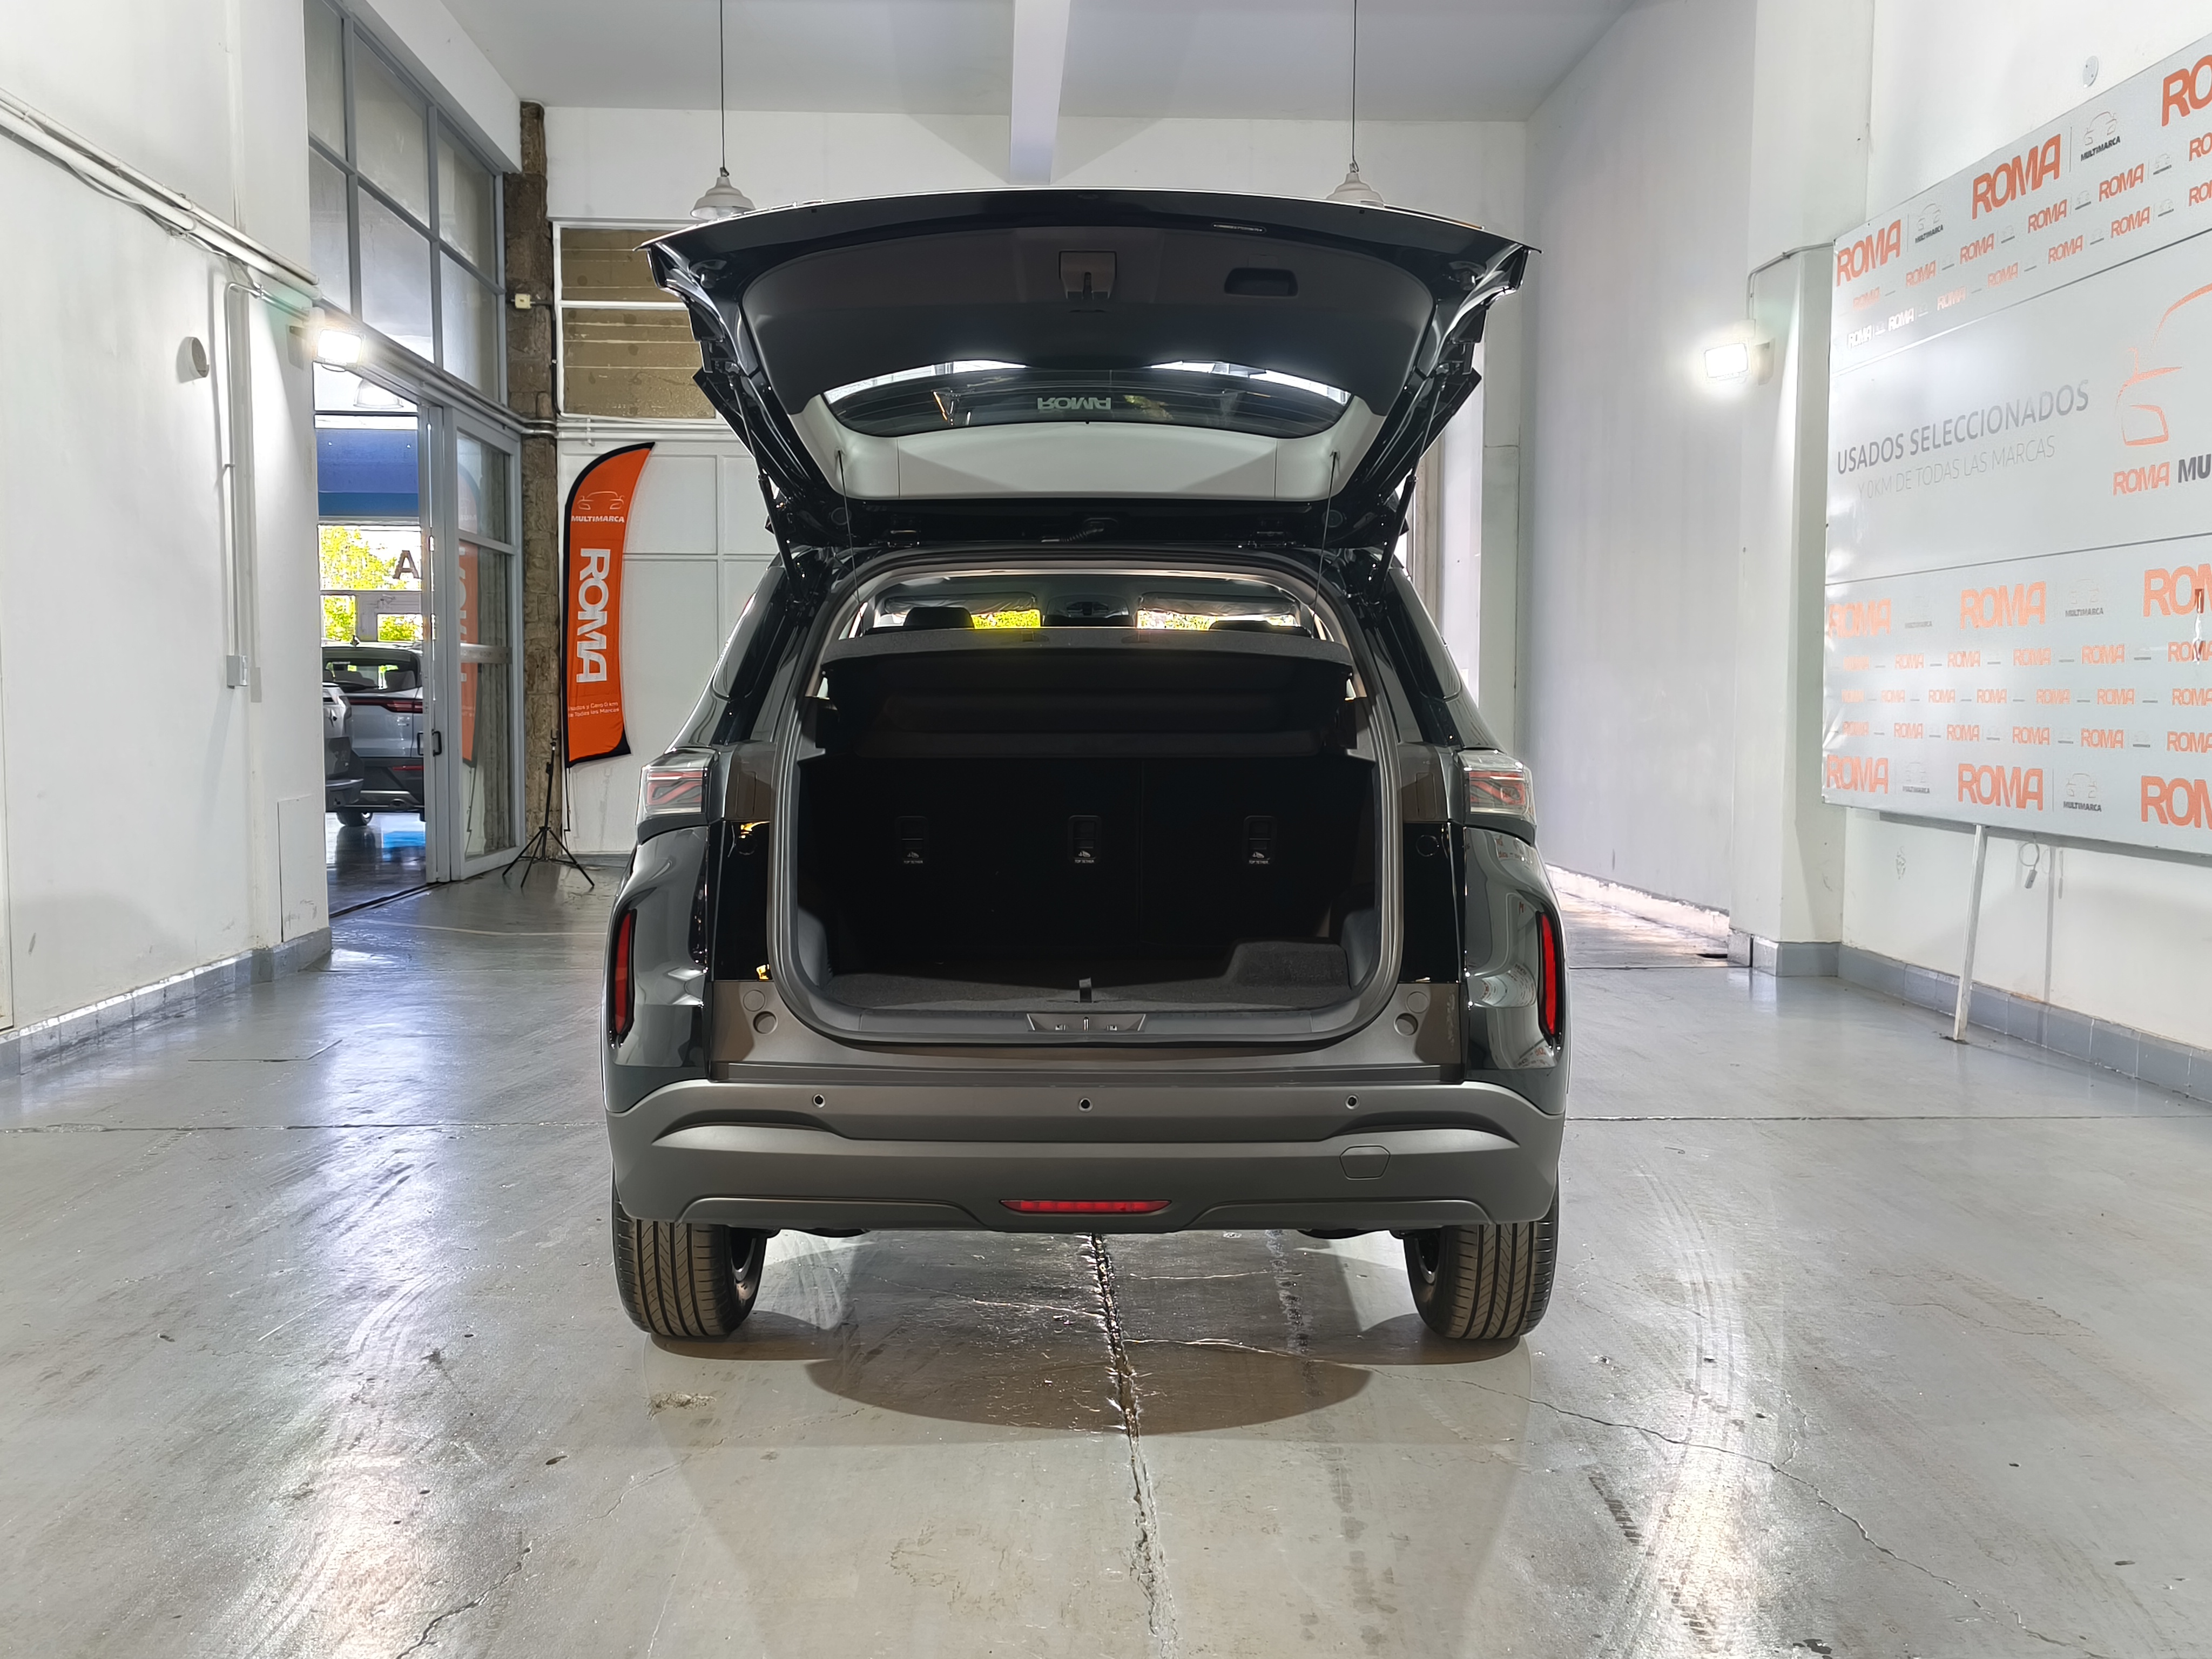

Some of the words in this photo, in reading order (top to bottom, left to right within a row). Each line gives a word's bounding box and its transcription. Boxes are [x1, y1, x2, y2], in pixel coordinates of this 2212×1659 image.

[1972, 134, 2061, 219] ROMA
[1906, 260, 1936, 287] ROMA
[1960, 233, 1994, 264] ROMA
[2028, 199, 2067, 233] ROMA
[2099, 164, 2144, 202] ROMA
[1837, 219, 1901, 286] ROMA
[1889, 308, 1914, 332] ROMA
[1988, 262, 2018, 288] ROMA
[2048, 235, 2083, 264] ROMA
[2110, 207, 2150, 238] ROMA
[2189, 180, 2212, 206] RO
[1838, 433, 1904, 474] USADOS
[1910, 380, 2089, 456] SELECCIONADOS
[1896, 470, 1912, 492] DE
[1916, 459, 1960, 487] TODAS
[1964, 452, 1987, 476] LAS
[1992, 435, 2055, 470] MARCAS
[2113, 461, 2170, 496] ROMA
[571, 515, 625, 523] MULTIMARCA
[576, 548, 611, 683] ROMA
[1827, 598, 1891, 639] ROMA
[1960, 581, 2046, 630] ROMA
[1947, 651, 1981, 667] ROMA
[2013, 648, 2051, 666] ROMA
[2081, 644, 2125, 664] ROMA
[1928, 689, 1955, 703] ROMA
[1977, 689, 2007, 704] ROMA
[2036, 689, 2071, 704] ROMA
[2097, 689, 2135, 705] ROMA
[1947, 724, 1980, 742] ROMA
[2013, 726, 2050, 745] ROMA
[2081, 728, 2124, 748] ROMA
[1826, 754, 1889, 794] ROMA
[1958, 763, 2044, 811] ROMA
